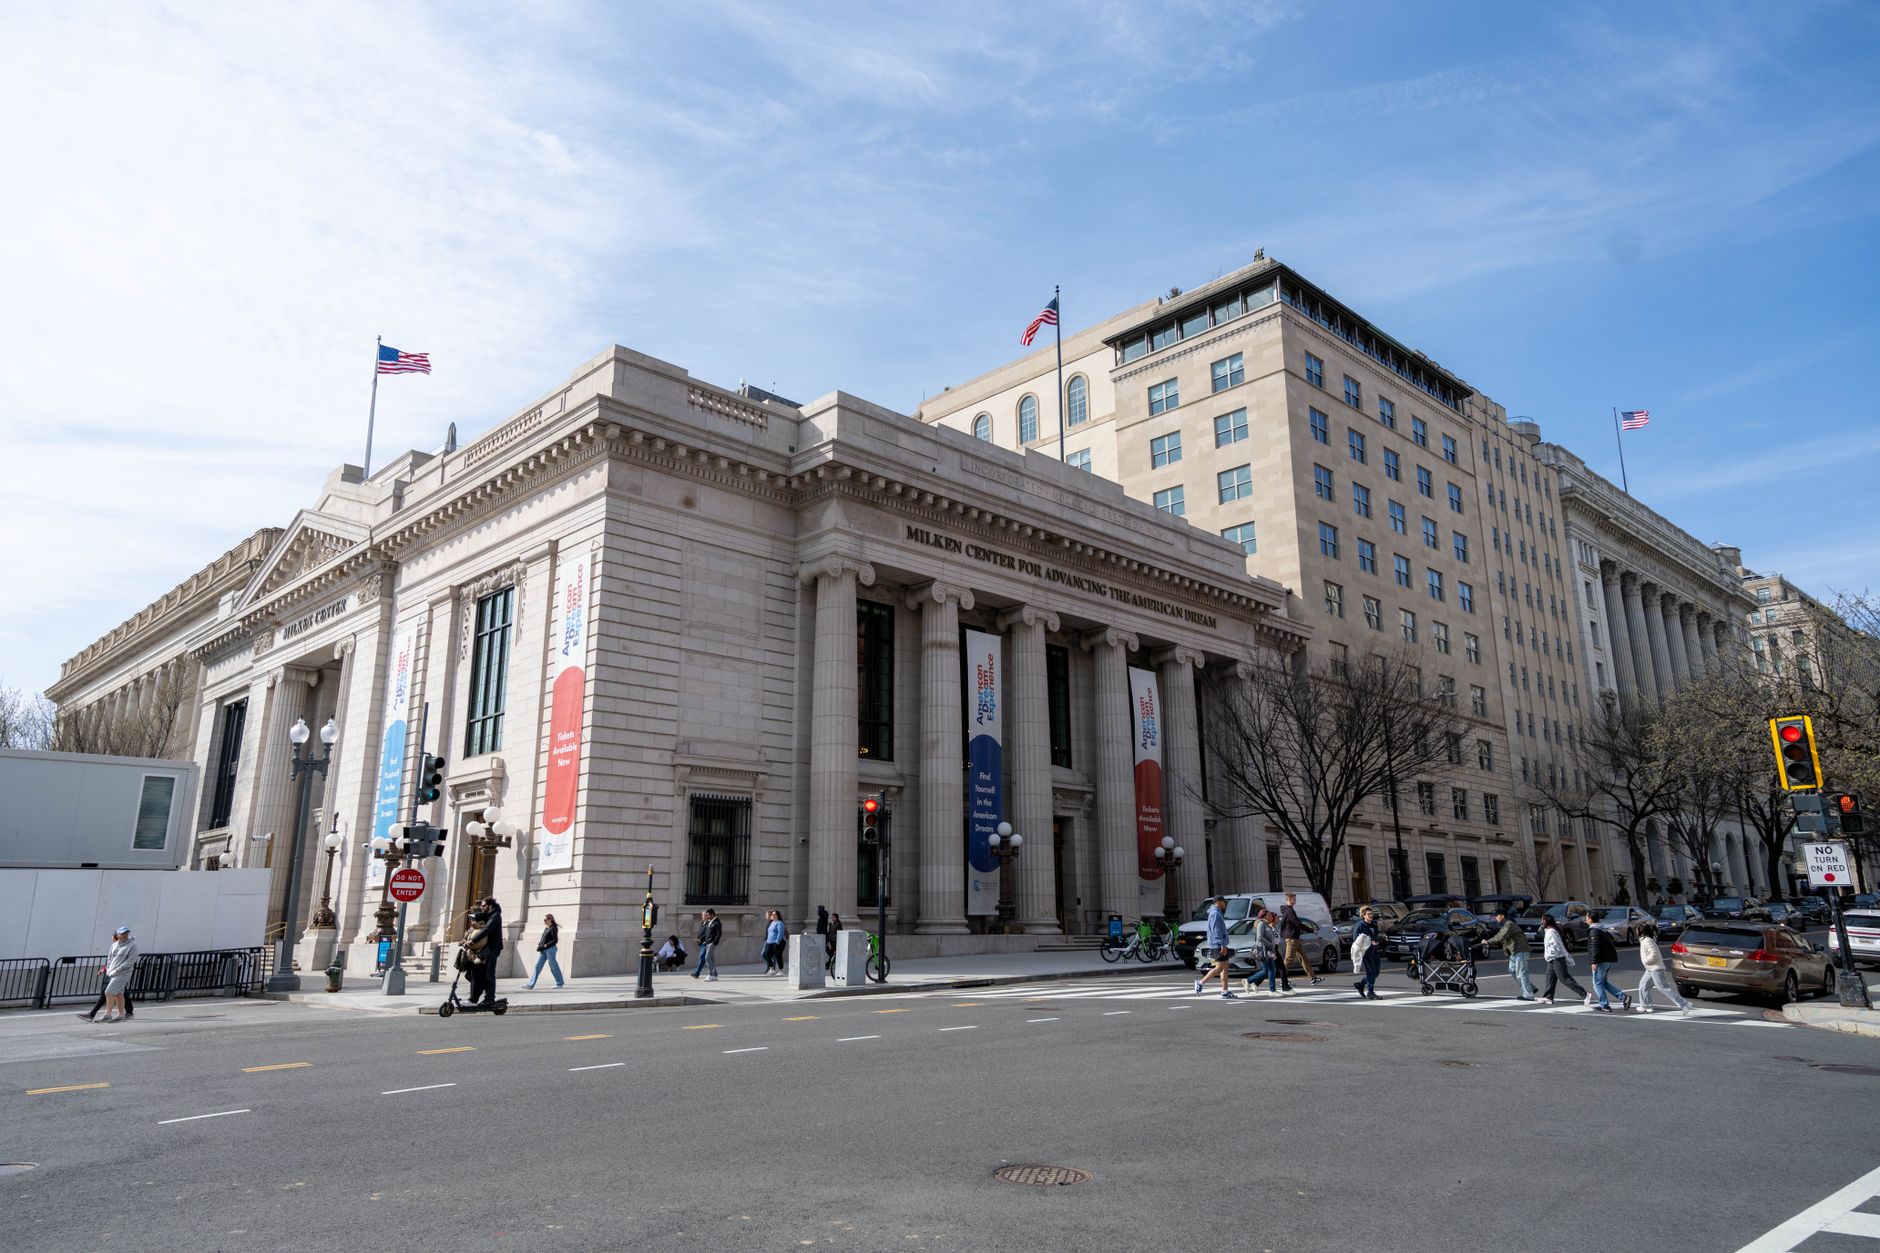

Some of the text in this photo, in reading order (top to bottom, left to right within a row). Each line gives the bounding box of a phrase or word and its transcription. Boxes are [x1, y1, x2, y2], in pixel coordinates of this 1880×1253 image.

[906, 525, 1217, 629] MILKEN CENTER FOR ADVANCING THE AMERICAN DREAM
[987, 653, 997, 722] Experience
[976, 664, 984, 726] American
[1147, 687, 1158, 747] Experience
[1139, 696, 1148, 751] American
[553, 742, 577, 756] Available
[557, 758, 571, 767] Now
[979, 771, 991, 780] Find
[975, 784, 996, 794] Yourself
[976, 797, 992, 807] in the
[973, 810, 998, 820] American
[975, 823, 994, 833] Dream
[1815, 846, 1833, 855] NO
[1827, 864, 1846, 872] RED
